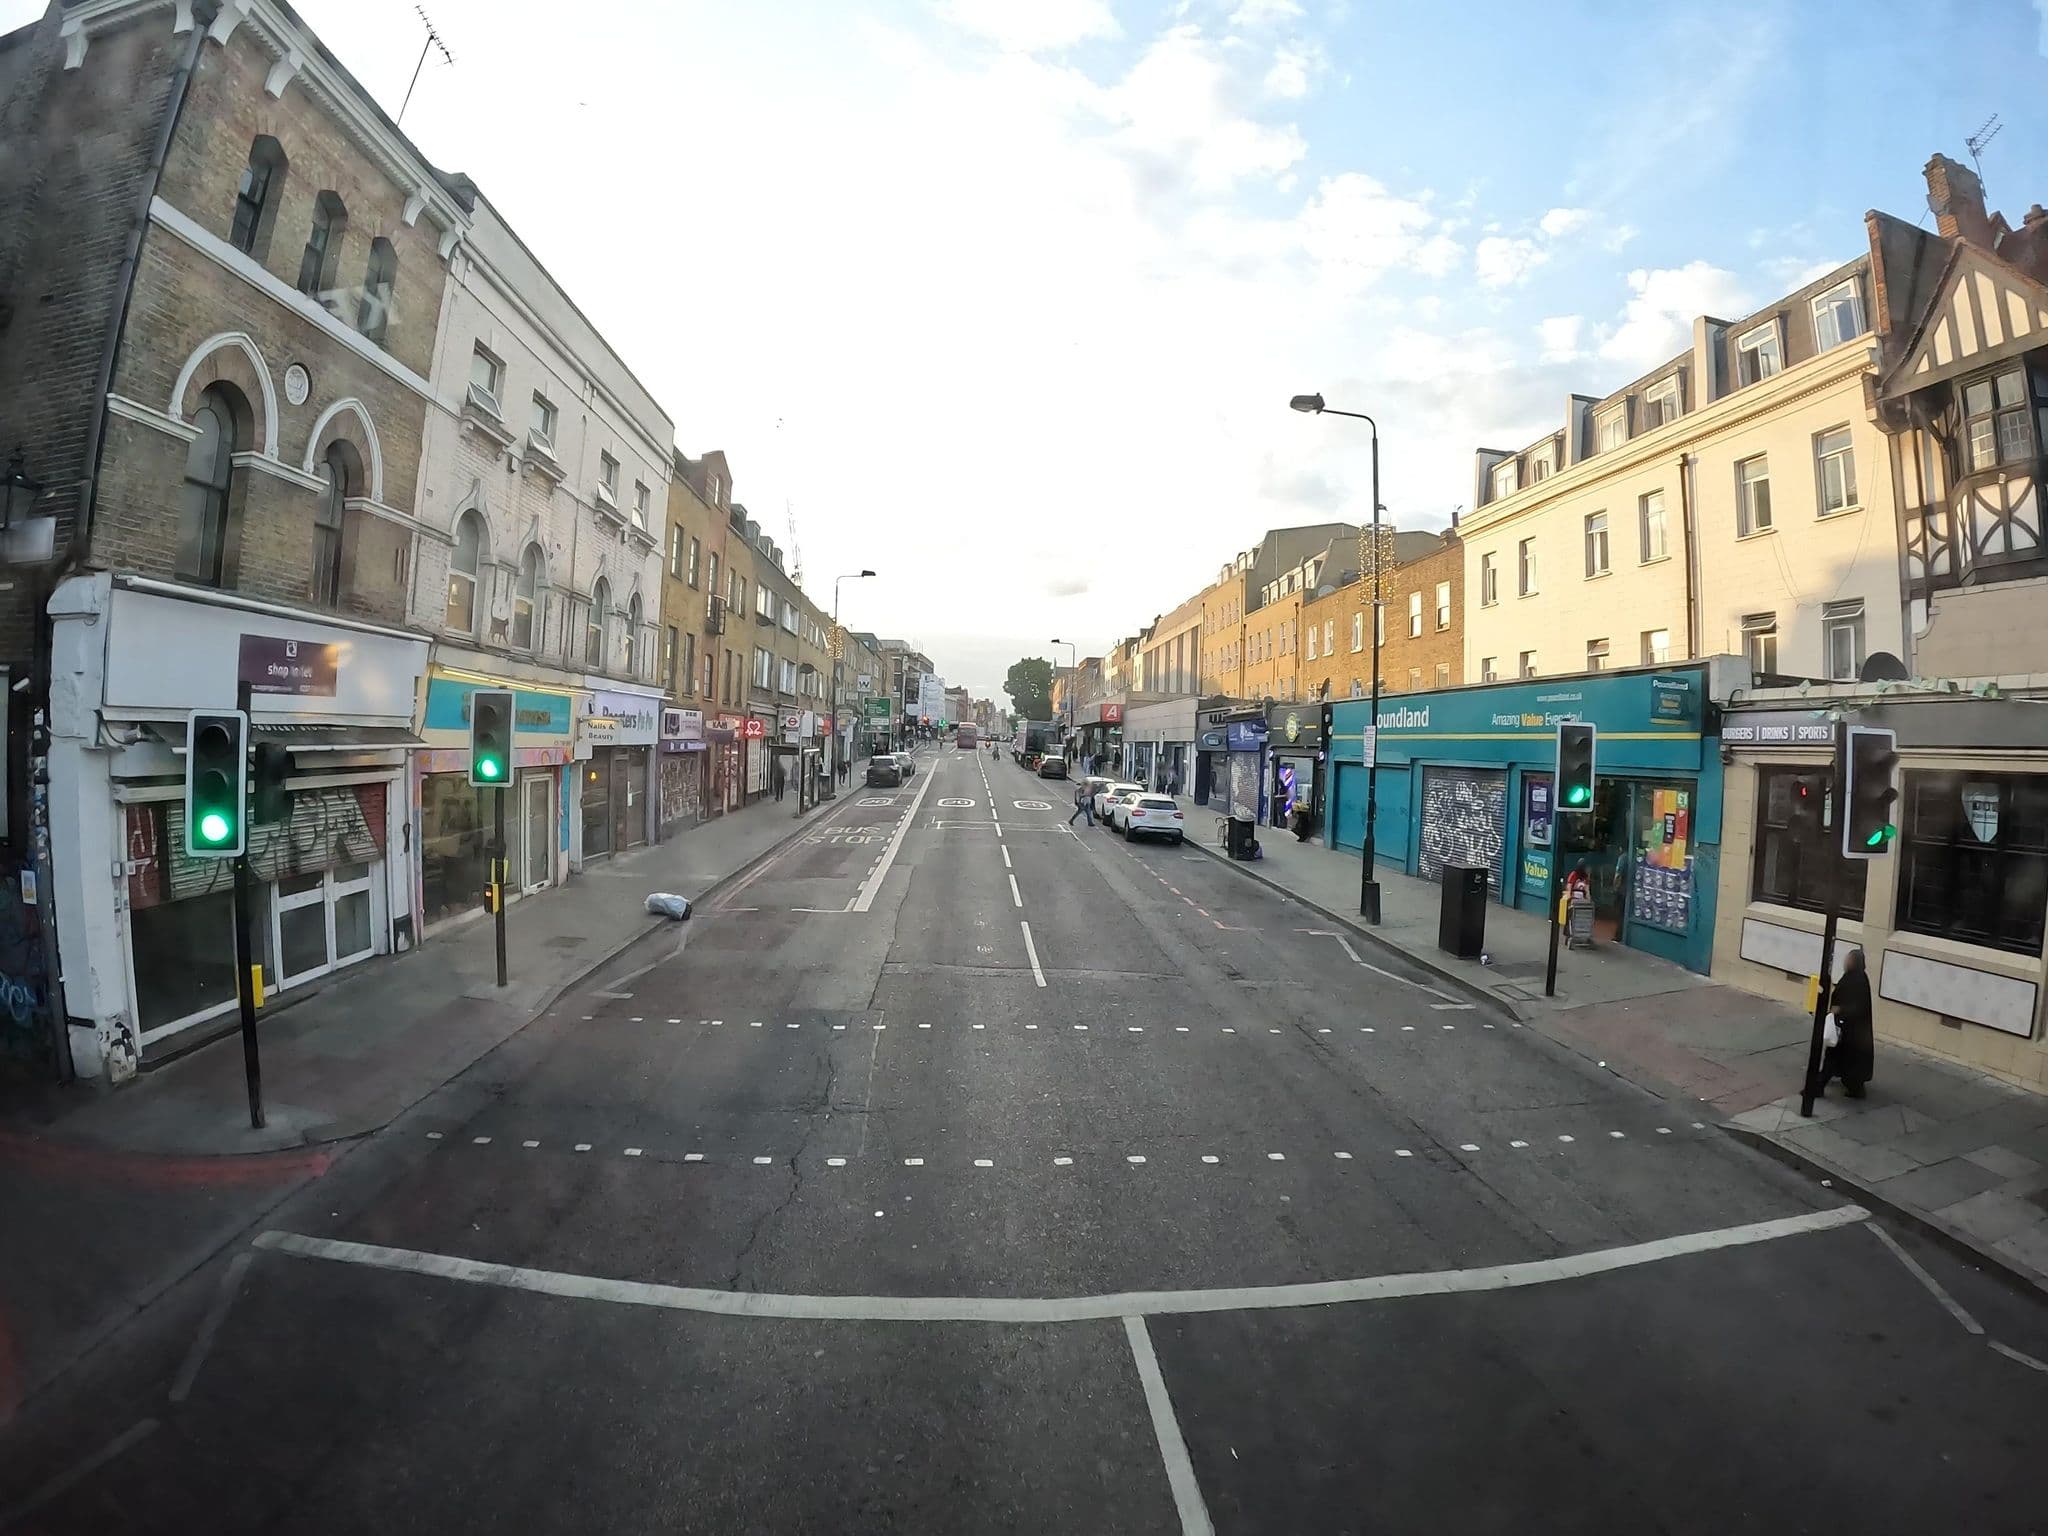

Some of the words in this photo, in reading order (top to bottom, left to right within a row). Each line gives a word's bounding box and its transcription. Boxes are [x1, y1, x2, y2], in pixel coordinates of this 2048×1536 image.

[267, 663, 289, 679] shop
[1376, 705, 1429, 728] oundland
[1491, 713, 1520, 728] Amazing
[1521, 713, 1544, 727] Value
[608, 722, 615, 730] &
[1761, 726, 1789, 740] DRINKS
[1798, 726, 1828, 739] SPORTS
[588, 732, 613, 740] Beauty
[824, 826, 881, 834] BUS
[803, 835, 892, 845] STOP
[1524, 861, 1549, 879] Value
